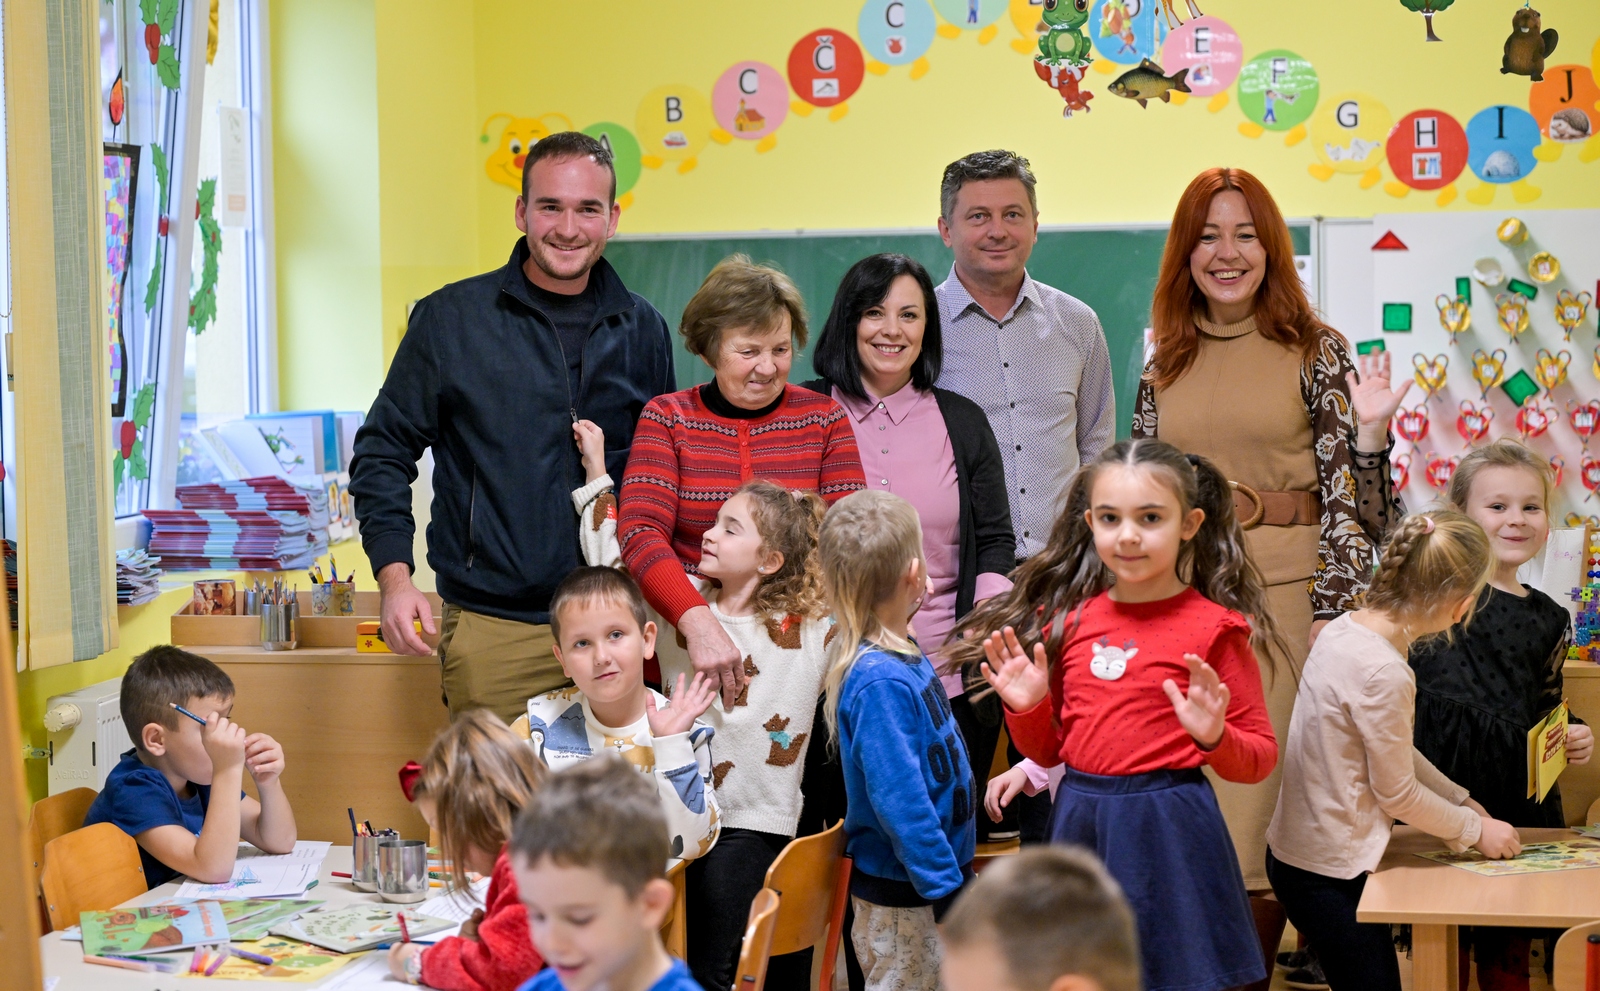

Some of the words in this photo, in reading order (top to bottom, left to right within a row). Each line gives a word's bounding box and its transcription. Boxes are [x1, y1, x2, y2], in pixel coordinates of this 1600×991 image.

[815, 36, 834, 71] Č
[1194, 27, 1209, 54] E
[738, 68, 757, 94] C
[1272, 58, 1285, 84] F
[1559, 69, 1574, 104] J
[666, 97, 683, 122] B
[1336, 101, 1359, 128] G
[1495, 105, 1507, 140] I
[1416, 119, 1436, 147] H
[927, 732, 960, 783] OF
